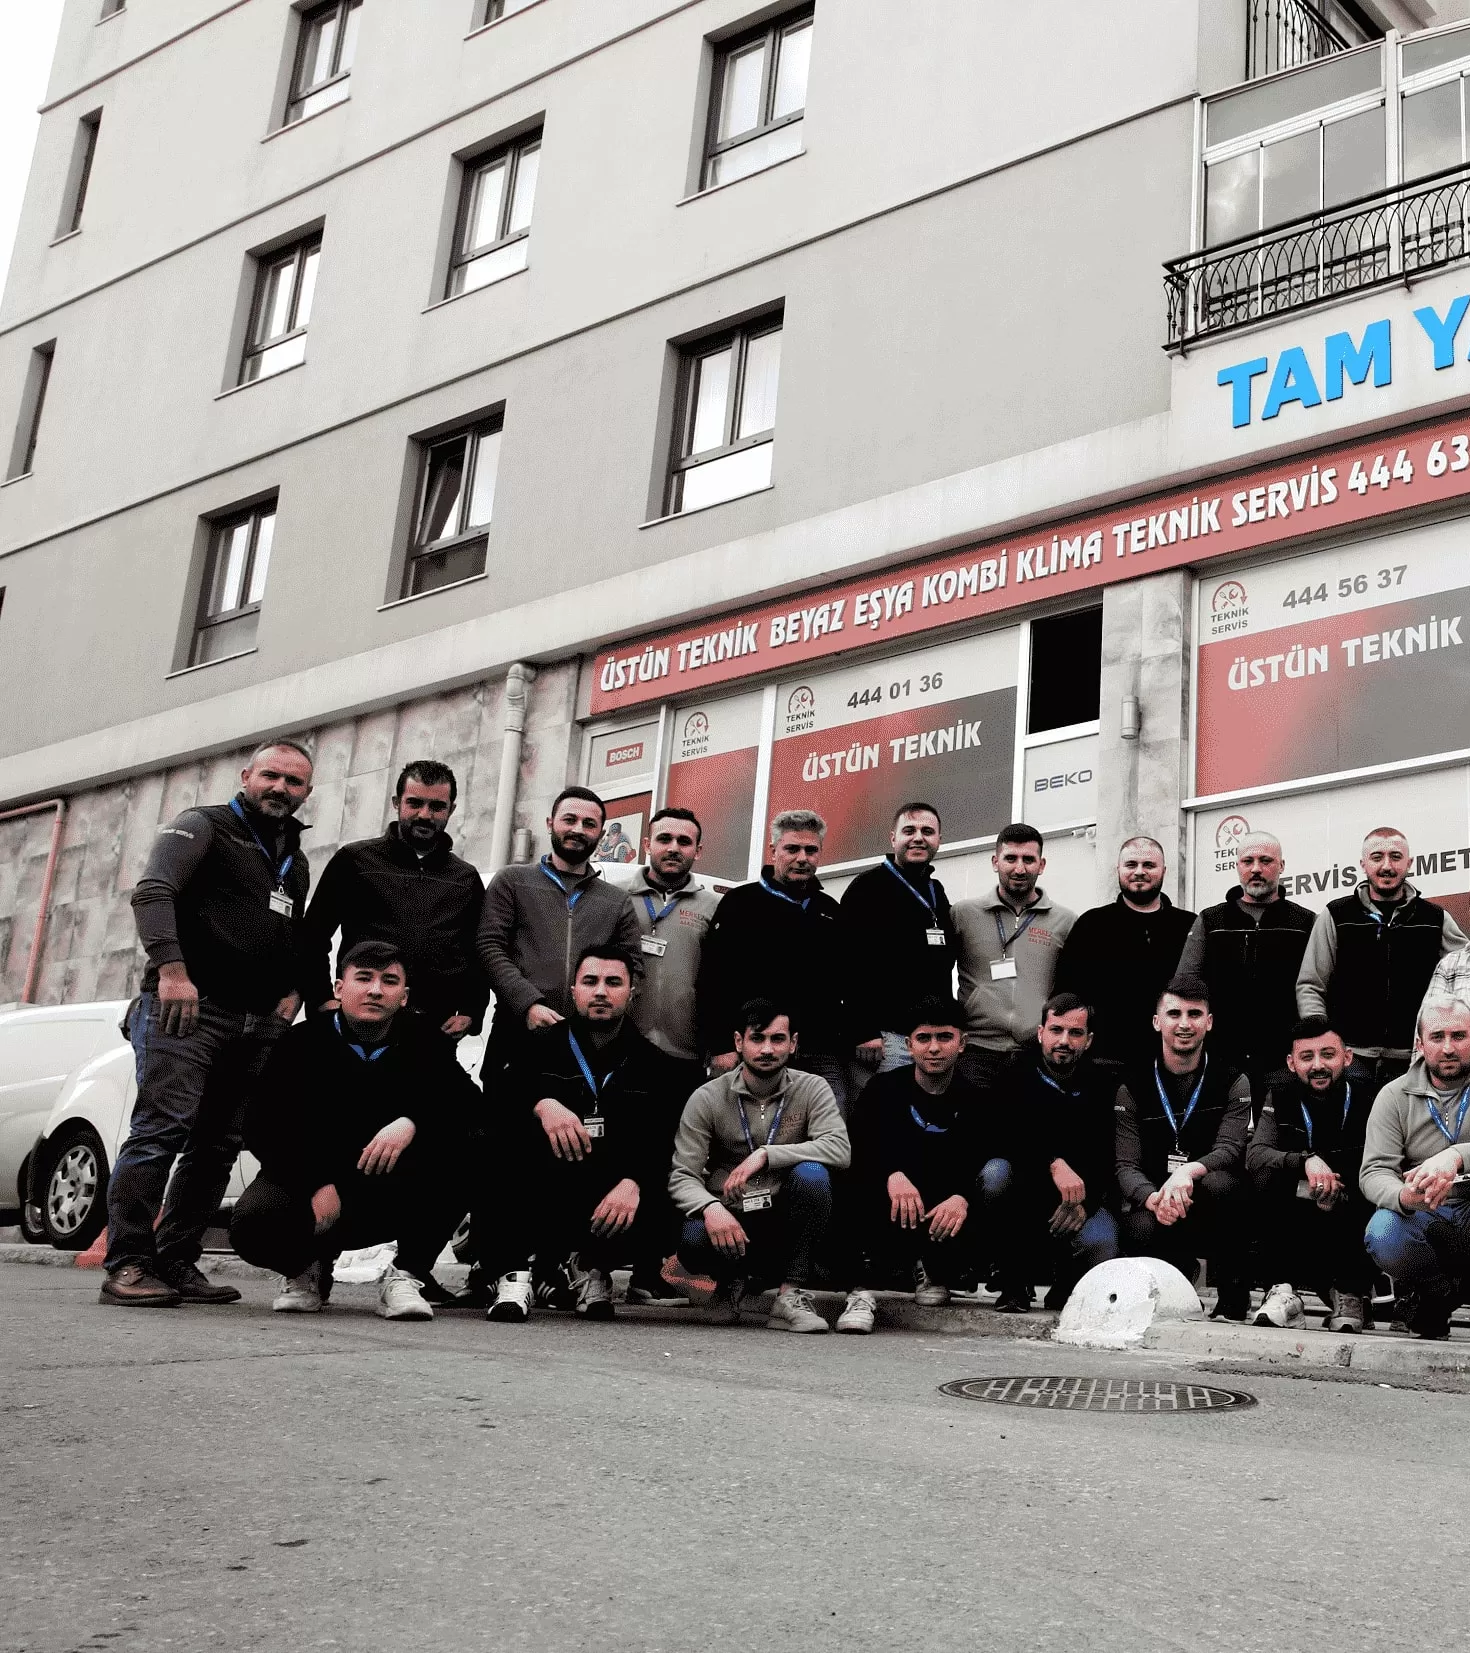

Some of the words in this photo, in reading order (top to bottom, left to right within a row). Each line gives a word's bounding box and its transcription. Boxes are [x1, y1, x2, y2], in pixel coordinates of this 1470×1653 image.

[1217, 319, 1392, 428] TAM
[600, 646, 671, 692] ÜSTÜN
[677, 621, 760, 672] TEKNİK
[769, 599, 847, 648] BEYAZ
[854, 581, 915, 630] EŞYA
[922, 549, 1008, 608] KOMBİ
[1015, 531, 1103, 583] KLİMA
[1112, 497, 1222, 557] TEKNİK
[1231, 465, 1338, 527] SERVİS
[1347, 449, 1414, 495] 444
[1426, 434, 1470, 477] 63
[1283, 583, 1328, 609] 444
[1338, 574, 1368, 598] 56
[1377, 564, 1408, 589] 37
[1210, 606, 1250, 623] TEKNİK
[1211, 619, 1249, 635] SERVİS
[1227, 643, 1328, 691] ÜSTÜN
[1341, 615, 1464, 667] TEKNİK
[847, 685, 882, 709] 444
[889, 678, 911, 701] 01
[919, 671, 943, 693] 36
[786, 709, 816, 723] TEKNİK
[786, 720, 814, 733] SERVİS
[681, 734, 710, 748] TEKNİK
[681, 745, 708, 758] SERVİS
[802, 742, 880, 783] ÜSTÜN
[888, 718, 982, 764] TEKNİK
[609, 746, 640, 764] BOSCH
[1034, 769, 1093, 793] BEKO
[1279, 863, 1358, 898] ERVİS
